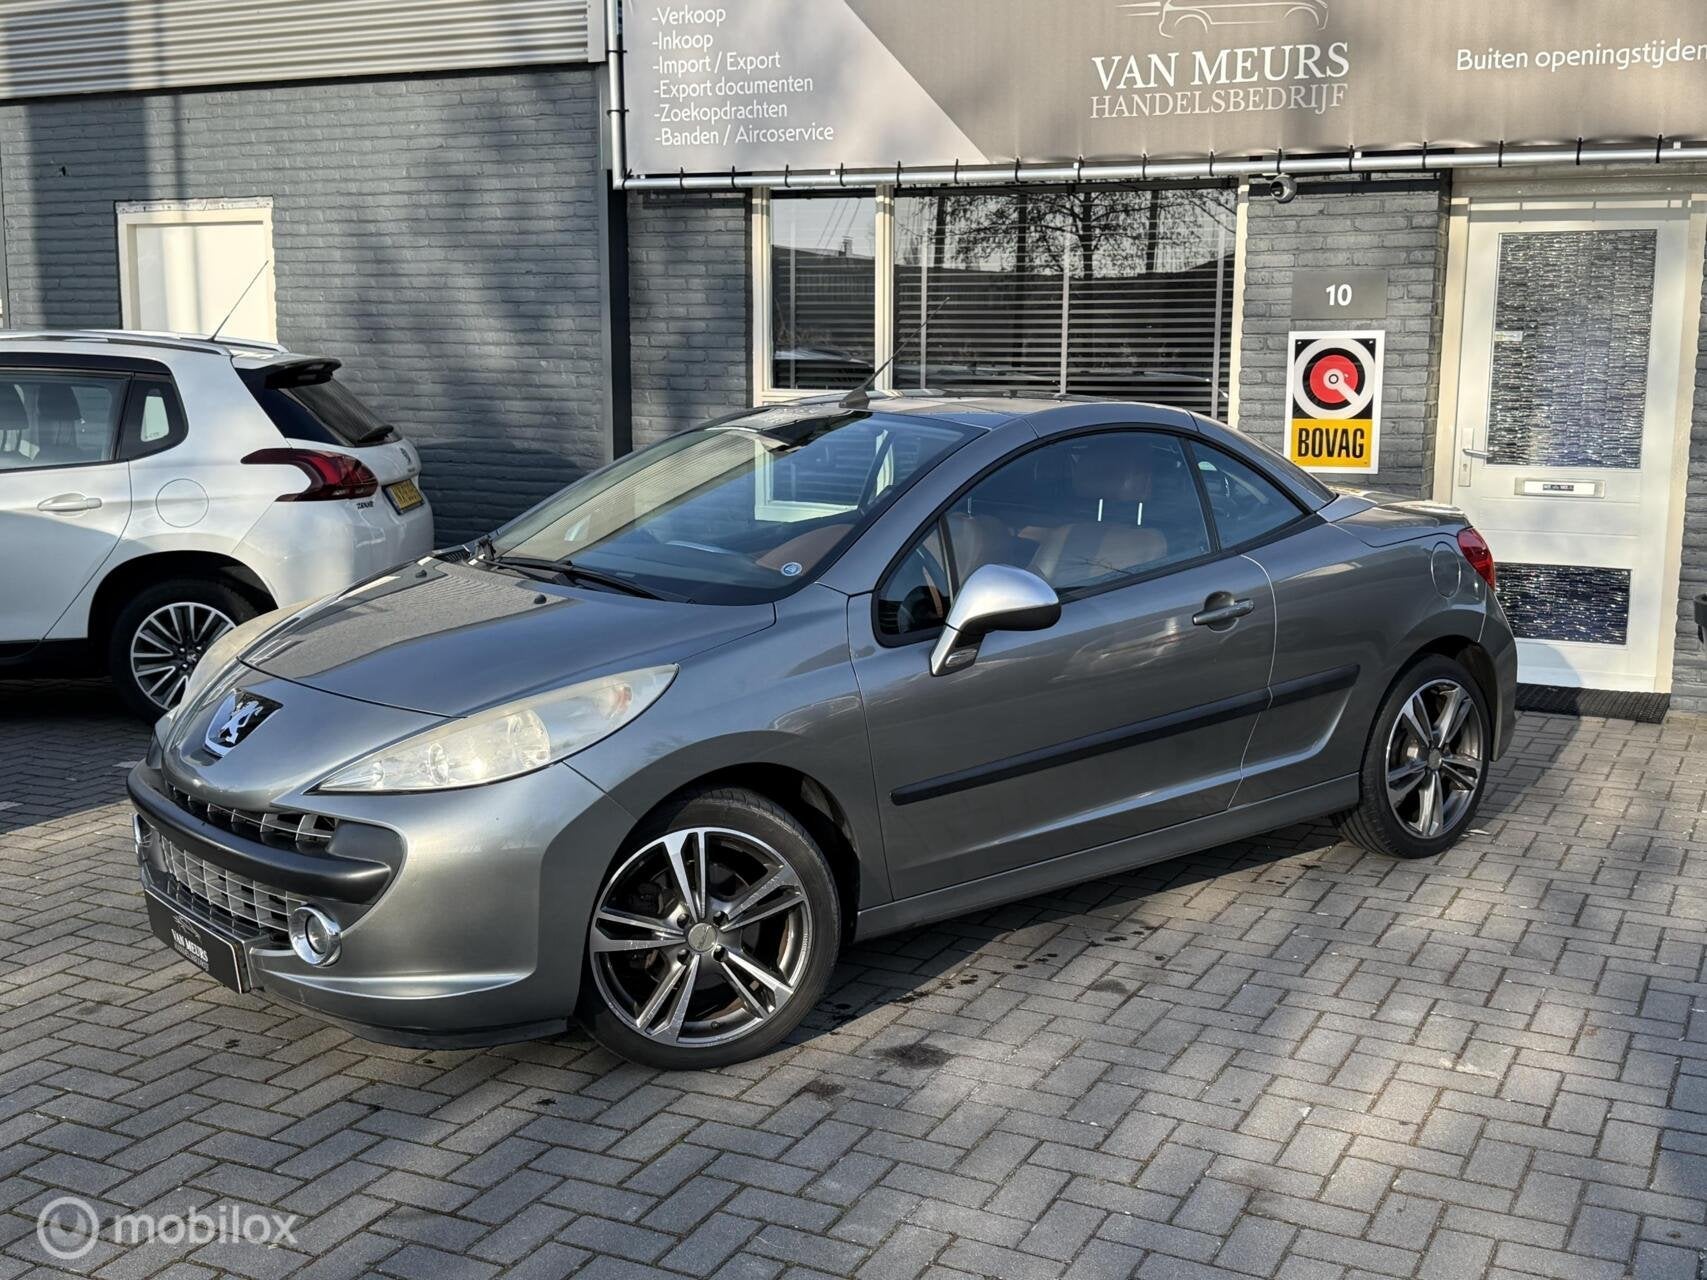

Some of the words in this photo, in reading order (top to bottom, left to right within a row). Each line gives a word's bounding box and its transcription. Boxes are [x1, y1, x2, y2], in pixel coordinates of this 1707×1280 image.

[651, 4, 727, 27] -Verkoop
[652, 30, 714, 52] -Inkoop
[652, 55, 711, 78] -Import
[714, 51, 723, 74] /
[726, 51, 781, 75] Export
[1091, 52, 1180, 91] VAN
[1190, 41, 1351, 86] MEURS
[1455, 47, 1529, 71] Buiten
[653, 79, 713, 102] -Export
[715, 76, 814, 96] documenten
[1090, 82, 1349, 119] HANDELSBEDRIJF
[653, 100, 788, 125] -Zoekopdrachten
[655, 126, 719, 147] -Banden
[722, 124, 732, 146] /
[734, 122, 835, 145] Aircoservice
[1325, 283, 1354, 307] 10
[1297, 427, 1365, 459] BOVAG
